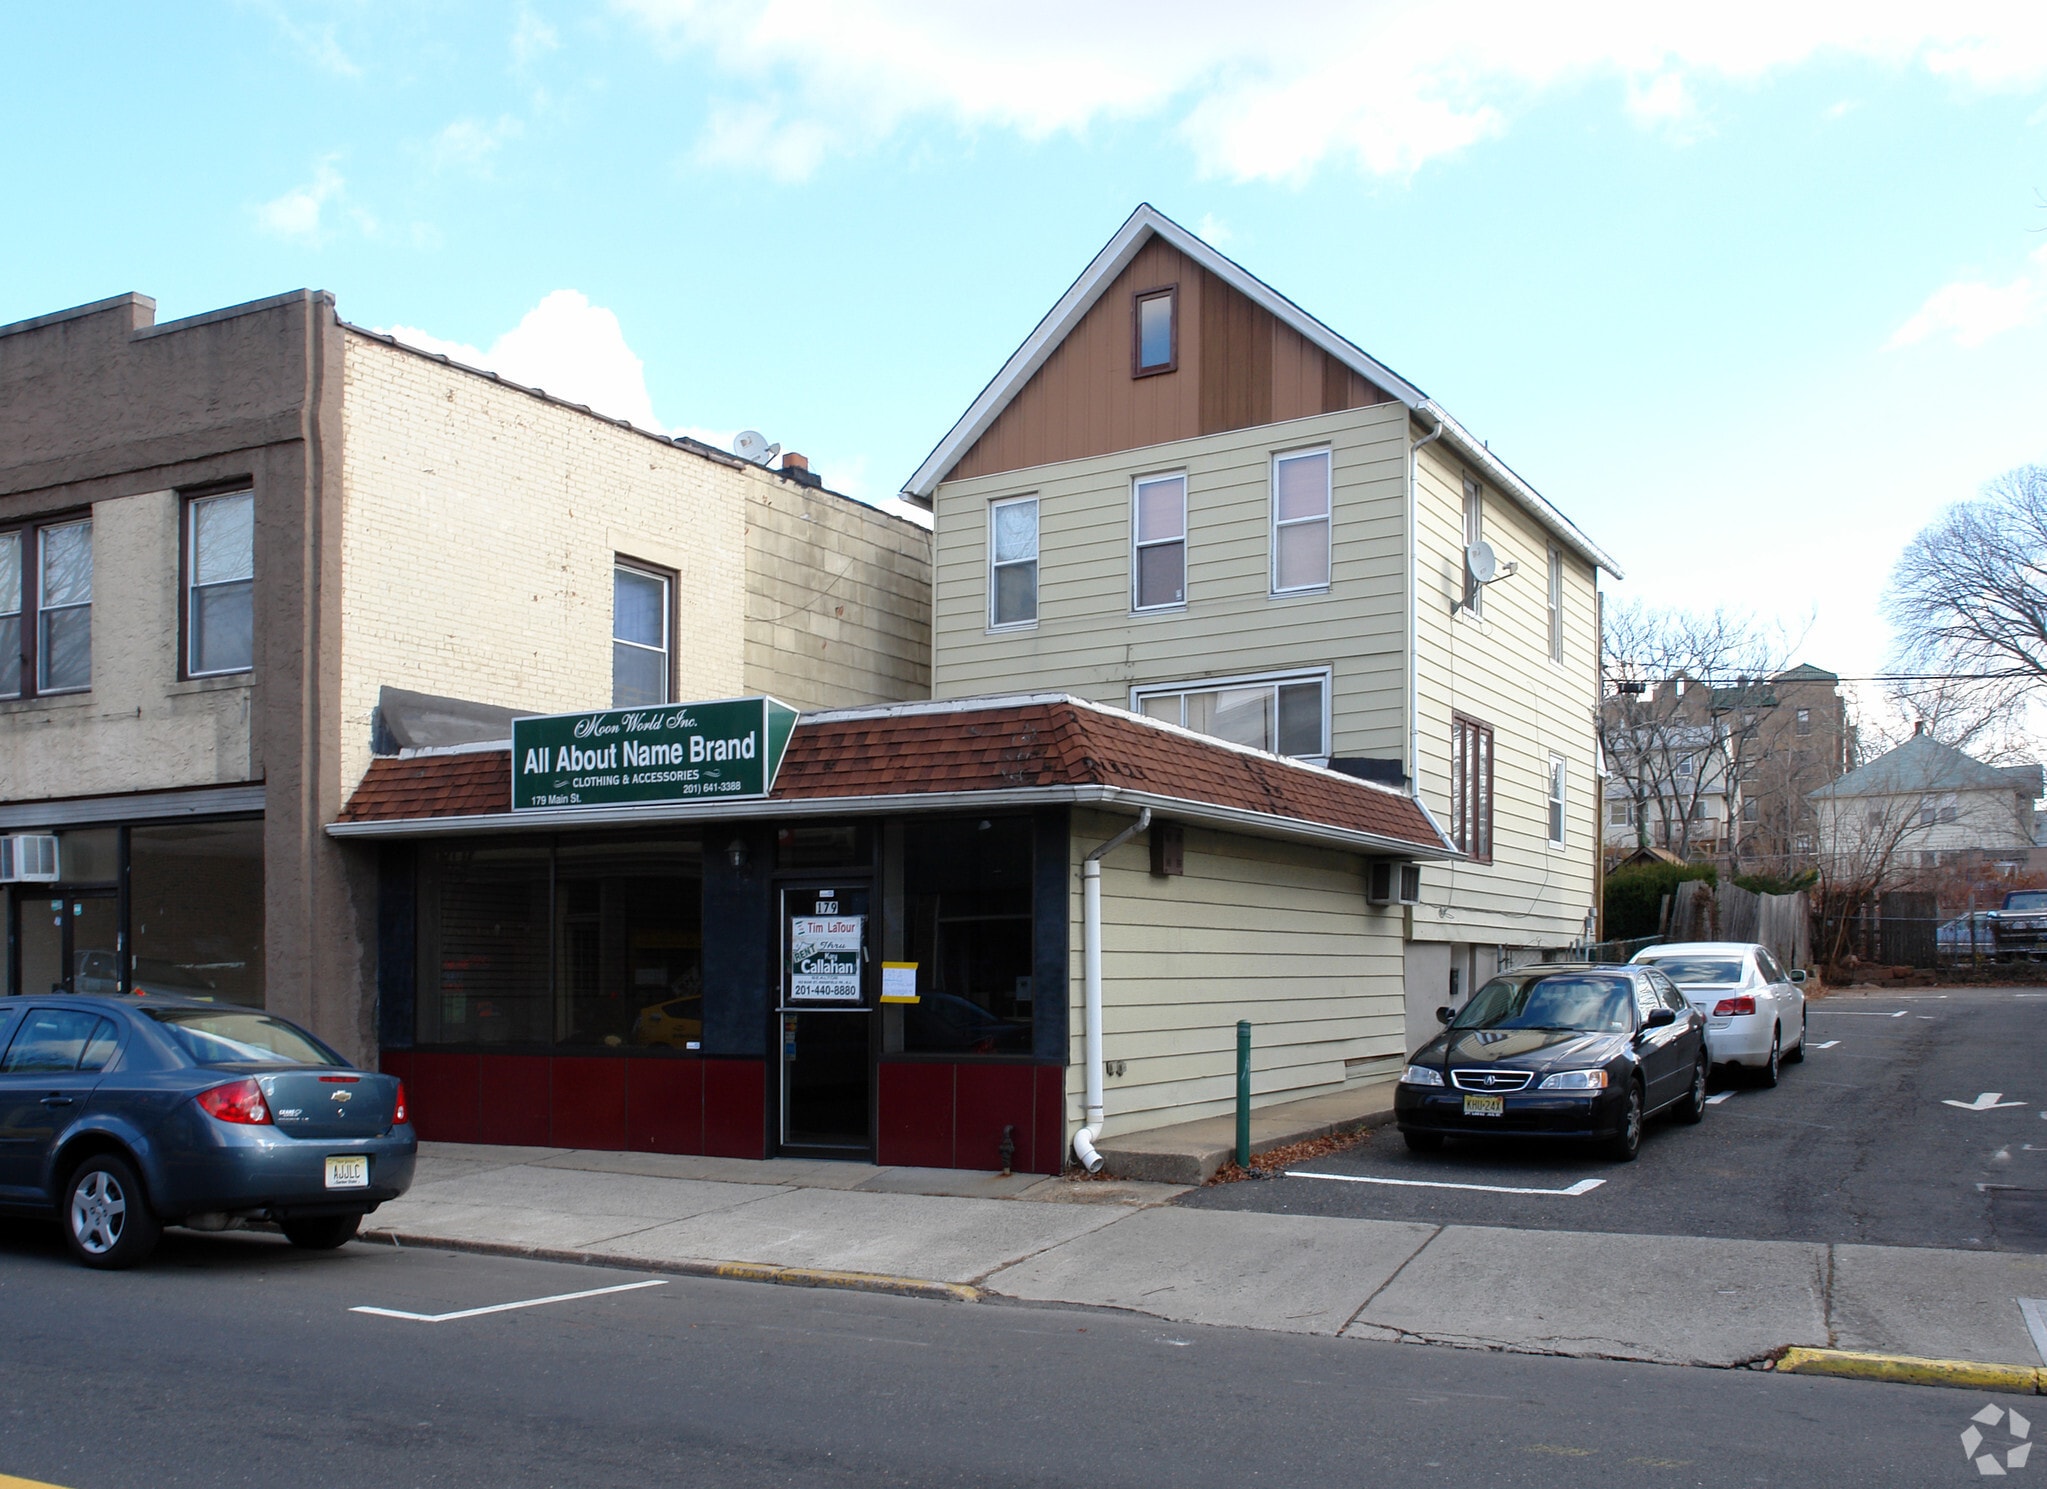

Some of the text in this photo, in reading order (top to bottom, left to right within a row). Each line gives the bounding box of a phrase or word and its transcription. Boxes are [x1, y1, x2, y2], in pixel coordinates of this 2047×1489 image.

[573, 709, 698, 738] Moon World Inc.
[523, 731, 756, 775] All About Name Brand
[572, 770, 699, 788] CLOTHING & ACCESSORIES
[702, 780, 741, 793] 641-3388
[531, 796, 547, 805] 179
[548, 794, 569, 804] Main
[818, 903, 837, 913] 179
[808, 921, 855, 933] Tim LaTour
[820, 941, 846, 949] Thru
[794, 943, 815, 962] RENT
[800, 959, 853, 974] Callahan
[795, 985, 856, 995] 201-440-8880
